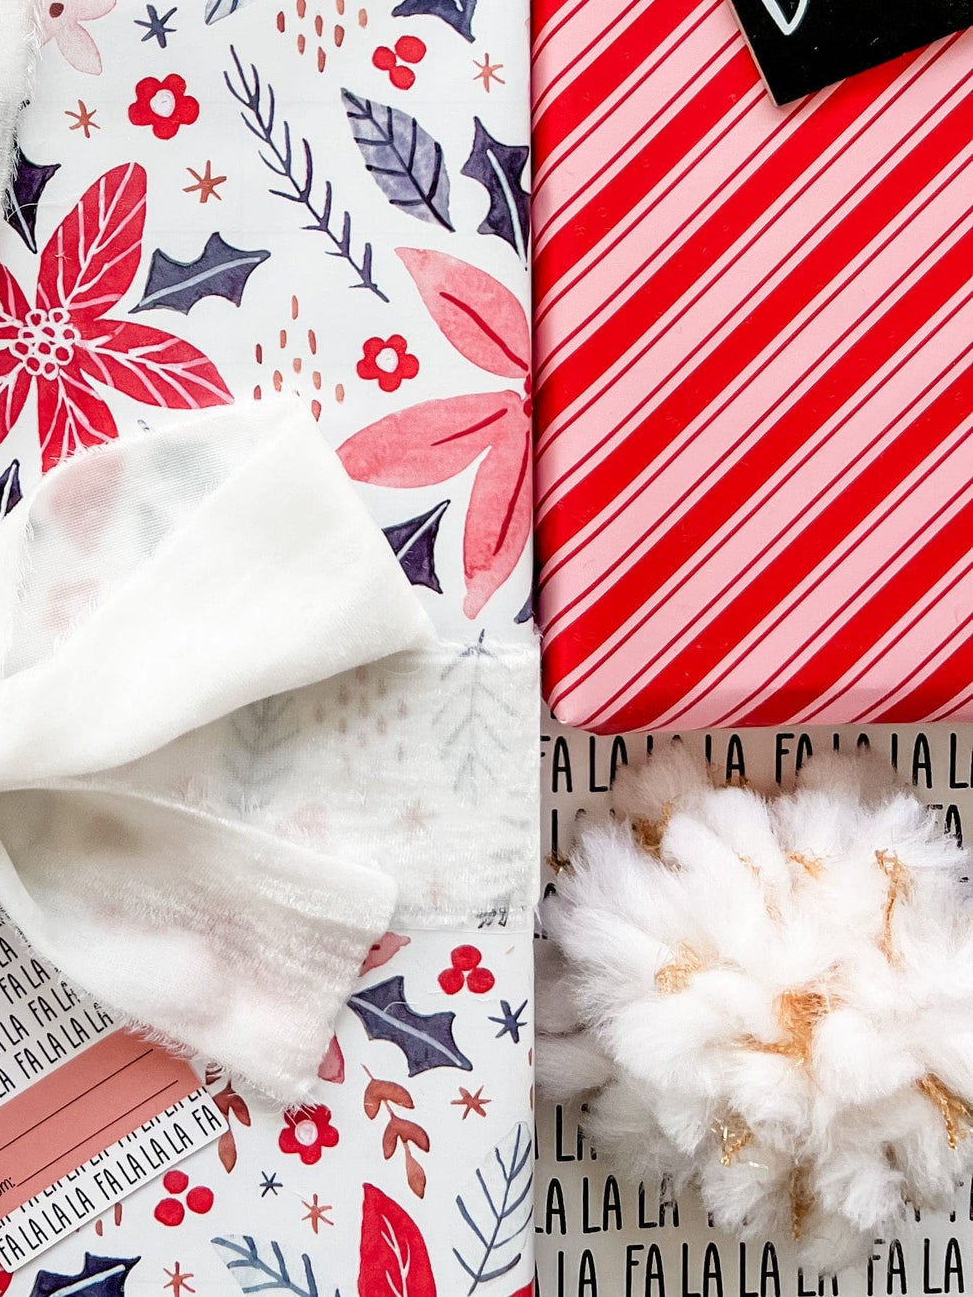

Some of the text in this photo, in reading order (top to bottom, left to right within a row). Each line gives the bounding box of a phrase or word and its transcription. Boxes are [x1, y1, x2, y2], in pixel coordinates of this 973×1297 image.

[19, 958, 51, 990] LA
[0, 1014, 30, 1046] LA
[27, 995, 58, 1028] FA
[13, 1047, 44, 1080] FA
[36, 1032, 68, 1064] LA
[59, 1017, 91, 1049] LA
[18, 1218, 49, 1251] LA
[41, 1202, 72, 1235] LA
[64, 1187, 96, 1219] LA
[93, 1168, 124, 1201] FA
[116, 1153, 147, 1185] LA
[139, 1138, 171, 1170] LA
[162, 1122, 194, 1155] LA
[191, 1104, 222, 1137] FA
[583, 1175, 622, 1233] LA
[626, 1244, 665, 1297] FA
[682, 1243, 723, 1297] LA
[740, 1241, 780, 1297] LA
[924, 1238, 964, 1294] LA
